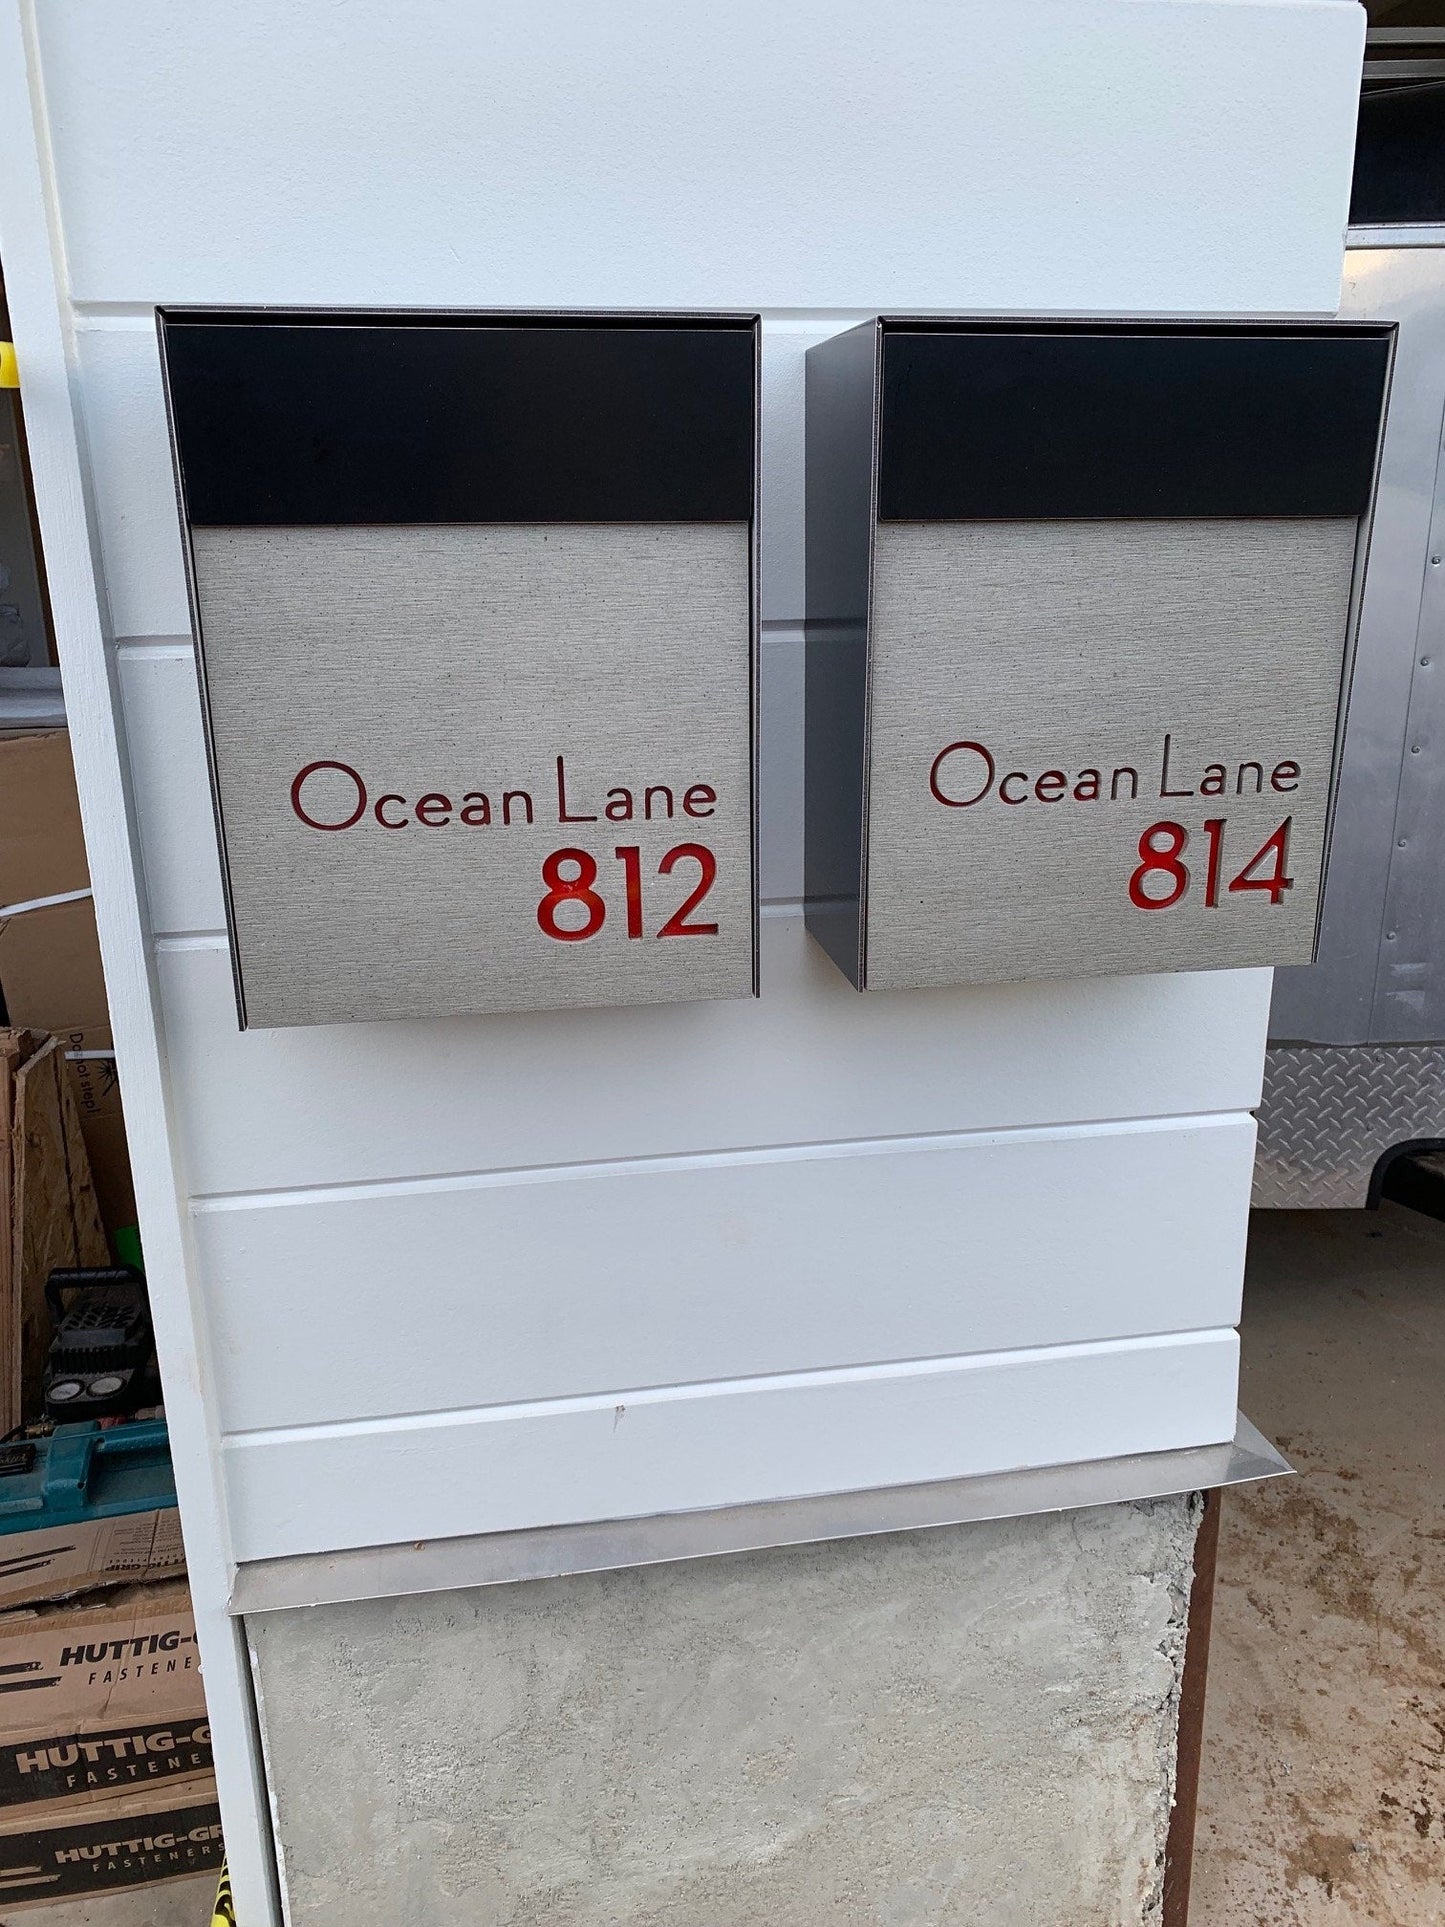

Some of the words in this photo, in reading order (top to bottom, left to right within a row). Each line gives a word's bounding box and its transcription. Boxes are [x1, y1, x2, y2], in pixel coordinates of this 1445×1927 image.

[290, 760, 534, 832] Ocean
[556, 755, 718, 823] Lane
[931, 741, 1138, 808] Ocean
[1159, 733, 1301, 798] Lane
[536, 842, 720, 942] 812
[1128, 815, 1295, 911] 814
[59, 1630, 198, 1667] HUTTIG-
[66, 1752, 201, 1788] FASTENE
[92, 1843, 225, 1873] FASTENERS
